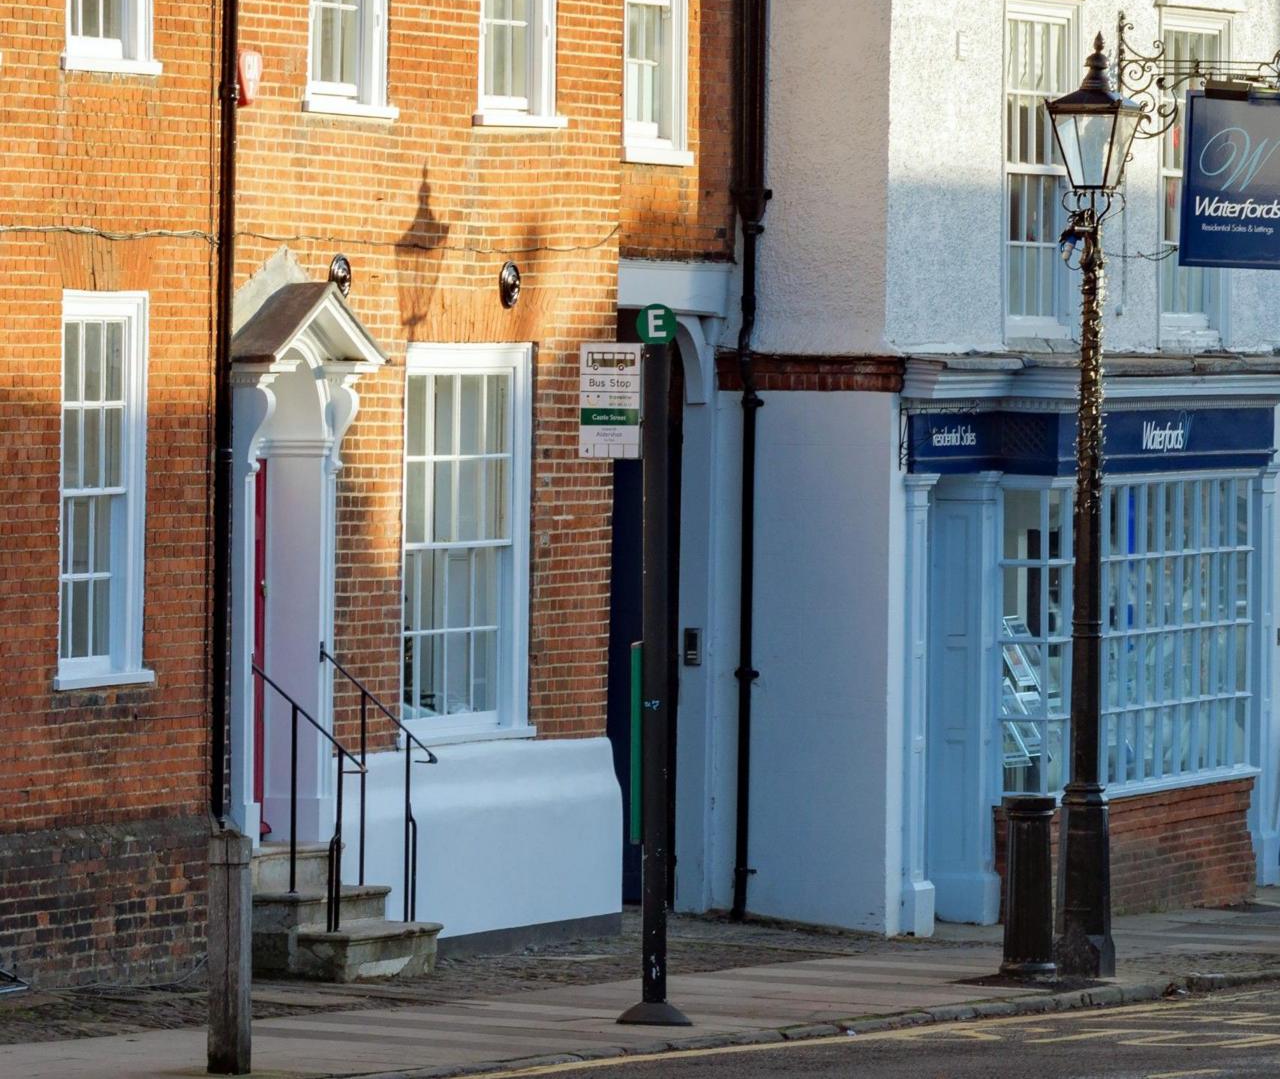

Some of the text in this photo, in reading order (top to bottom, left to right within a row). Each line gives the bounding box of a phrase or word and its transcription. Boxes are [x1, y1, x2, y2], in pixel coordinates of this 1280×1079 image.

[1201, 223, 1231, 232] Residential
[1231, 224, 1247, 232] Sales
[1247, 224, 1254, 233] &
[647, 309, 667, 338] E
[588, 378, 632, 389] Bus Stop
[1142, 420, 1184, 452] Waterfords
